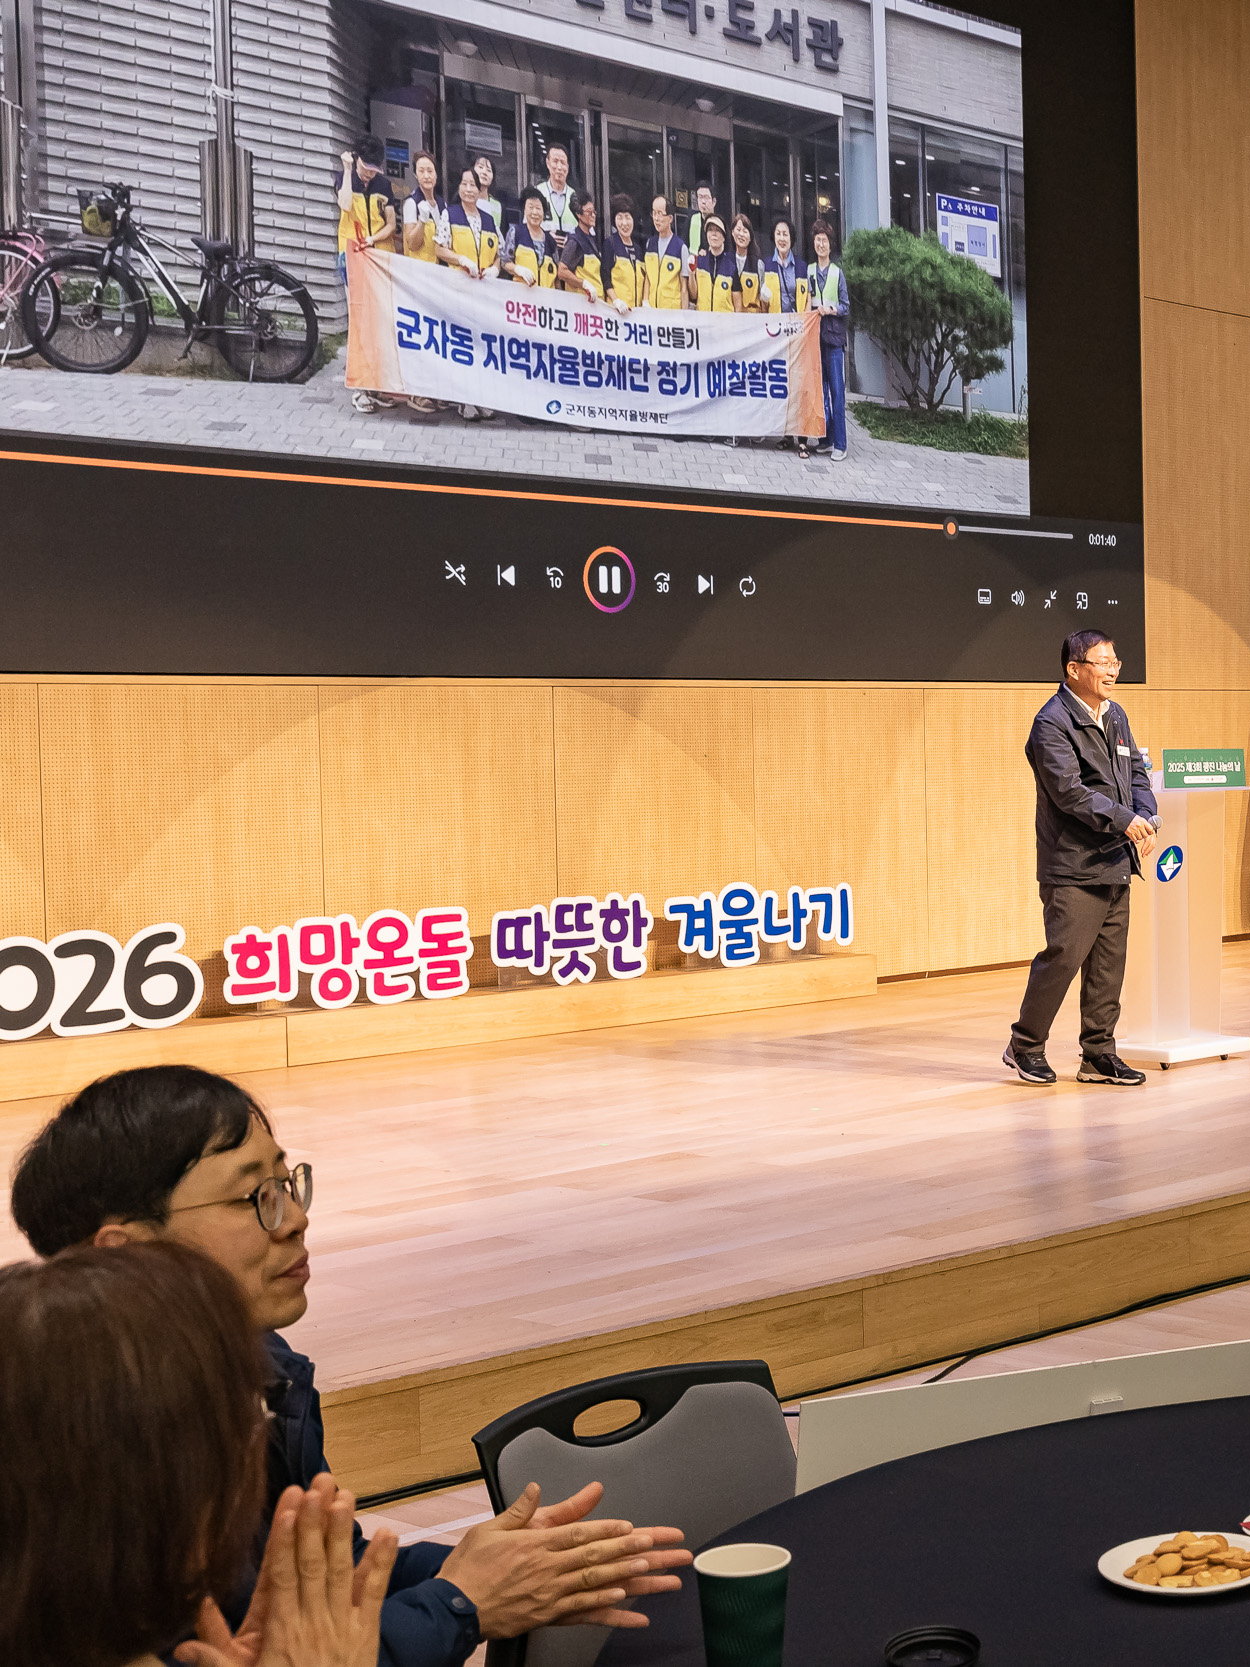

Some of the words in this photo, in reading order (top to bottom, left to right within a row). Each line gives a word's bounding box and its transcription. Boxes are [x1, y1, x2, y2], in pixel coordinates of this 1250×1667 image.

[941, 198, 947, 209] P
[957, 202, 986, 217] 주차안내
[505, 300, 569, 333] 안전하고
[573, 312, 620, 342] 깨끗한
[624, 322, 653, 347] 거리
[657, 325, 700, 351] 만들기
[396, 306, 475, 367] 군자동
[480, 332, 651, 395] 지역자율방재단
[656, 360, 700, 399] 정기
[706, 358, 789, 400] 예찰활동
[565, 403, 669, 425] 군자동지역자율방재단
[1088, 533, 1117, 547] 0:01:40
[550, 577, 562, 588] 10
[656, 582, 670, 593] 30
[1168, 762, 1185, 773] 2025
[1203, 761, 1215, 772] 광진
[1216, 761, 1234, 772] 나눔의
[1234, 761, 1241, 772] 날
[231, 912, 468, 1001] 희망온돌
[497, 899, 648, 979] 따뜻한
[669, 888, 848, 961] 겨울나기
